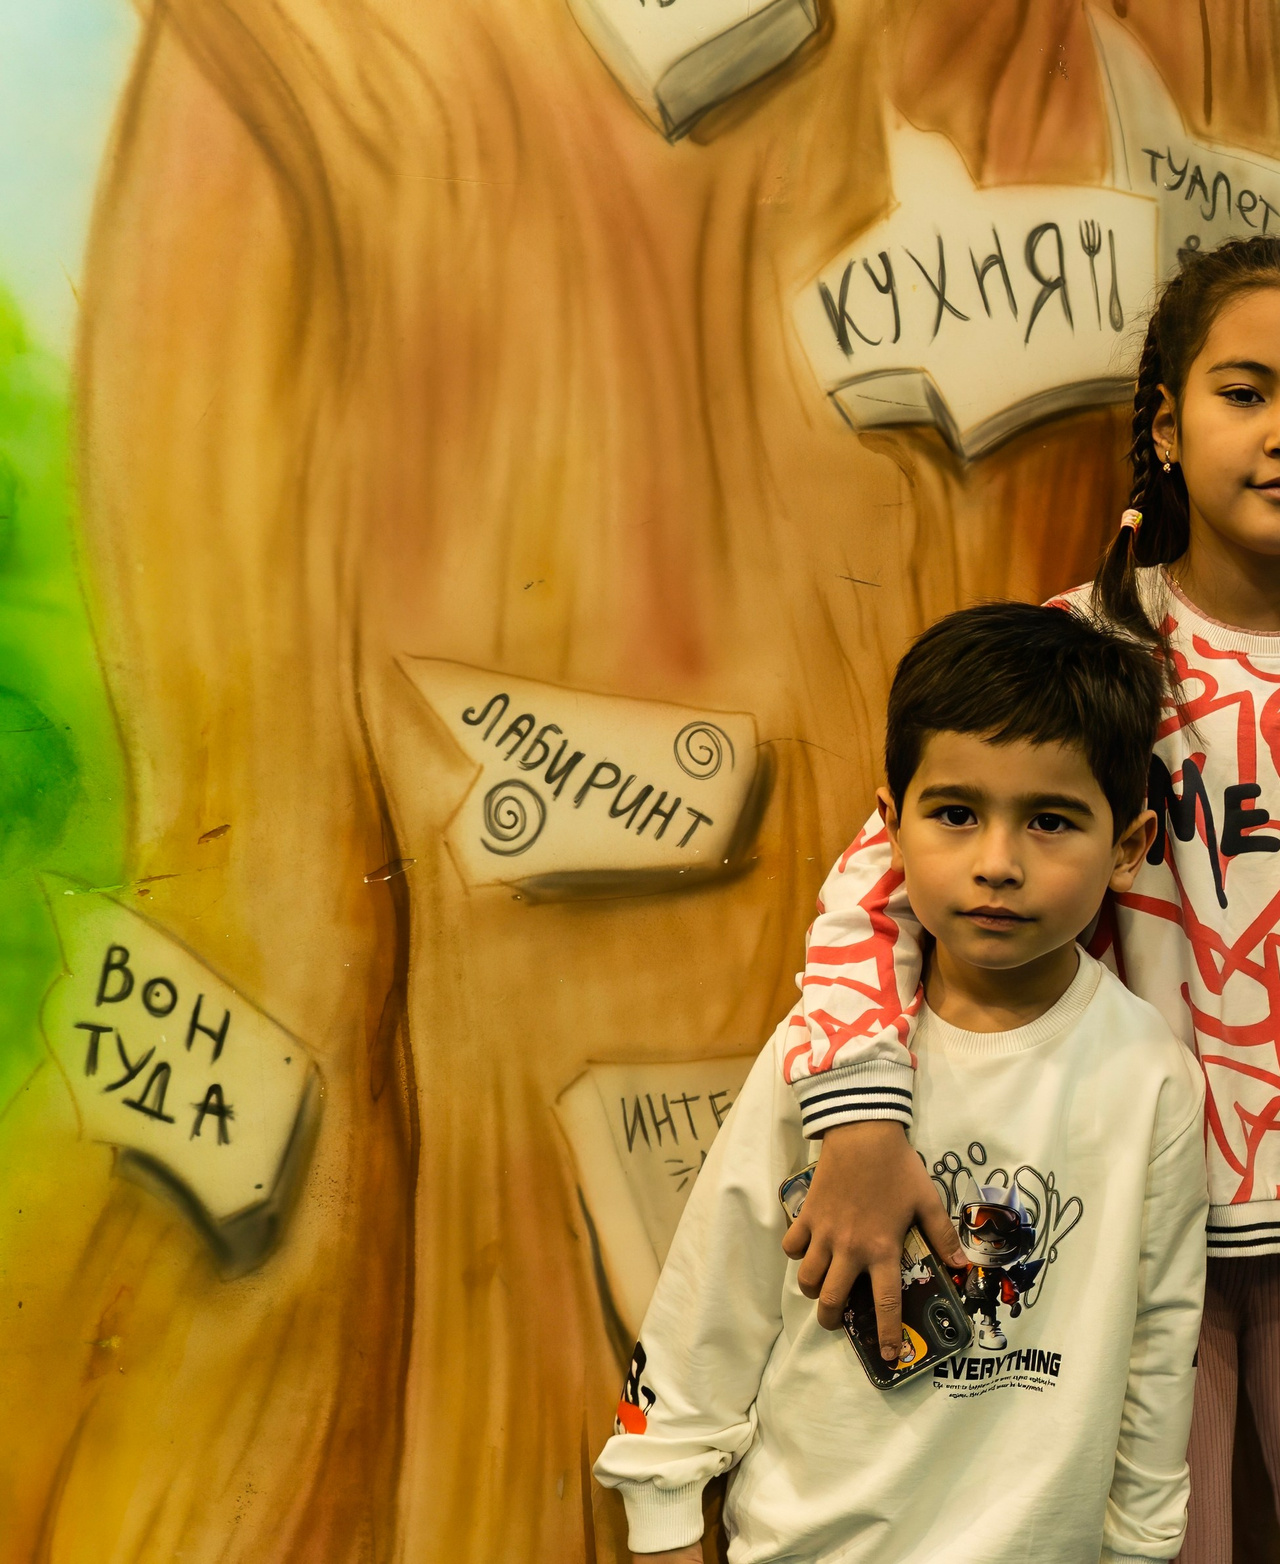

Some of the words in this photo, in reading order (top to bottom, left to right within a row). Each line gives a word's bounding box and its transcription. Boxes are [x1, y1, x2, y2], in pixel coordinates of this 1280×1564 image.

[817, 221, 1075, 360] КУХНЯ
[462, 692, 714, 848] ЛАБИРИНТ
[96, 942, 231, 1064] ВОН
[74, 1019, 236, 1146] ТУДА
[620, 1089, 744, 1153] ИНТЕ
[933, 1348, 1062, 1380] EVERYTHING
